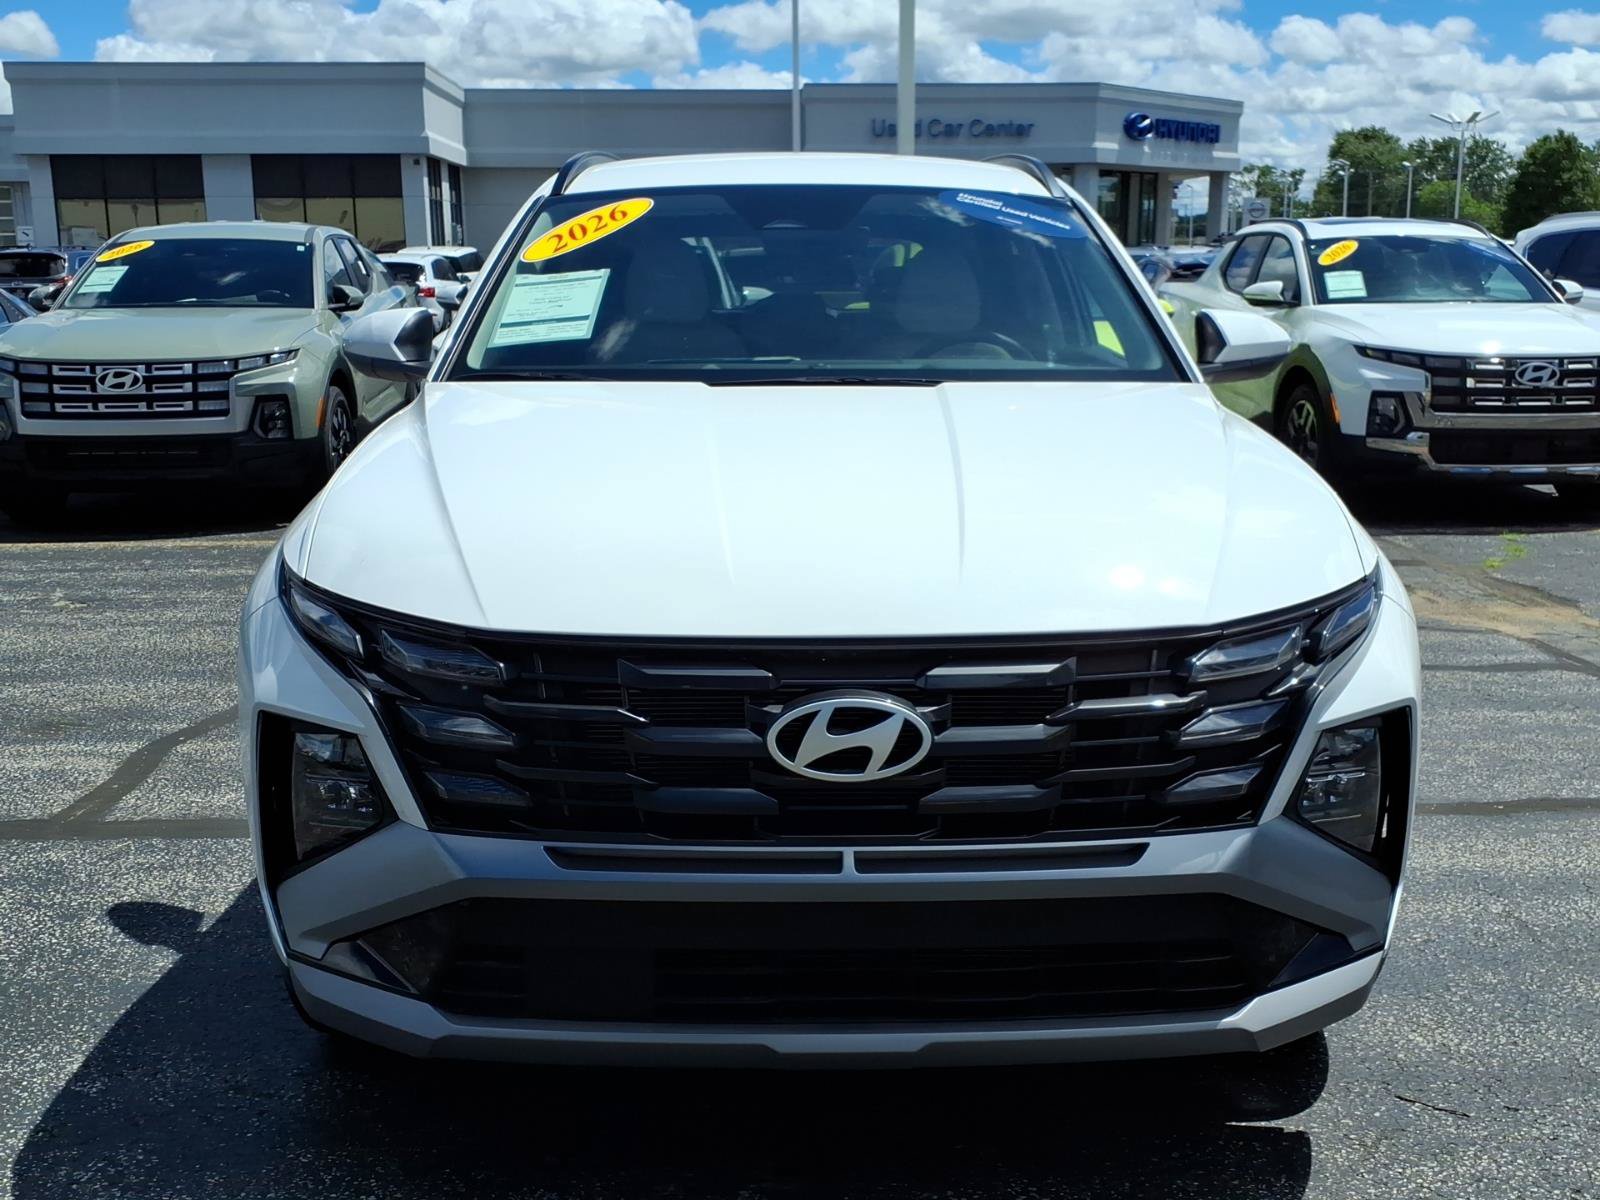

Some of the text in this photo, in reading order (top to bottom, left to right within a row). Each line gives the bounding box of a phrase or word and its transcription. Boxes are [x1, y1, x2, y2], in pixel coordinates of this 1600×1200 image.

[872, 118, 1035, 138] Usd Car Center
[1155, 118, 1220, 143] HYUNDAI
[547, 204, 628, 253] 2026
[1001, 206, 1028, 217] Used
[1029, 213, 1070, 230] Vehicles
